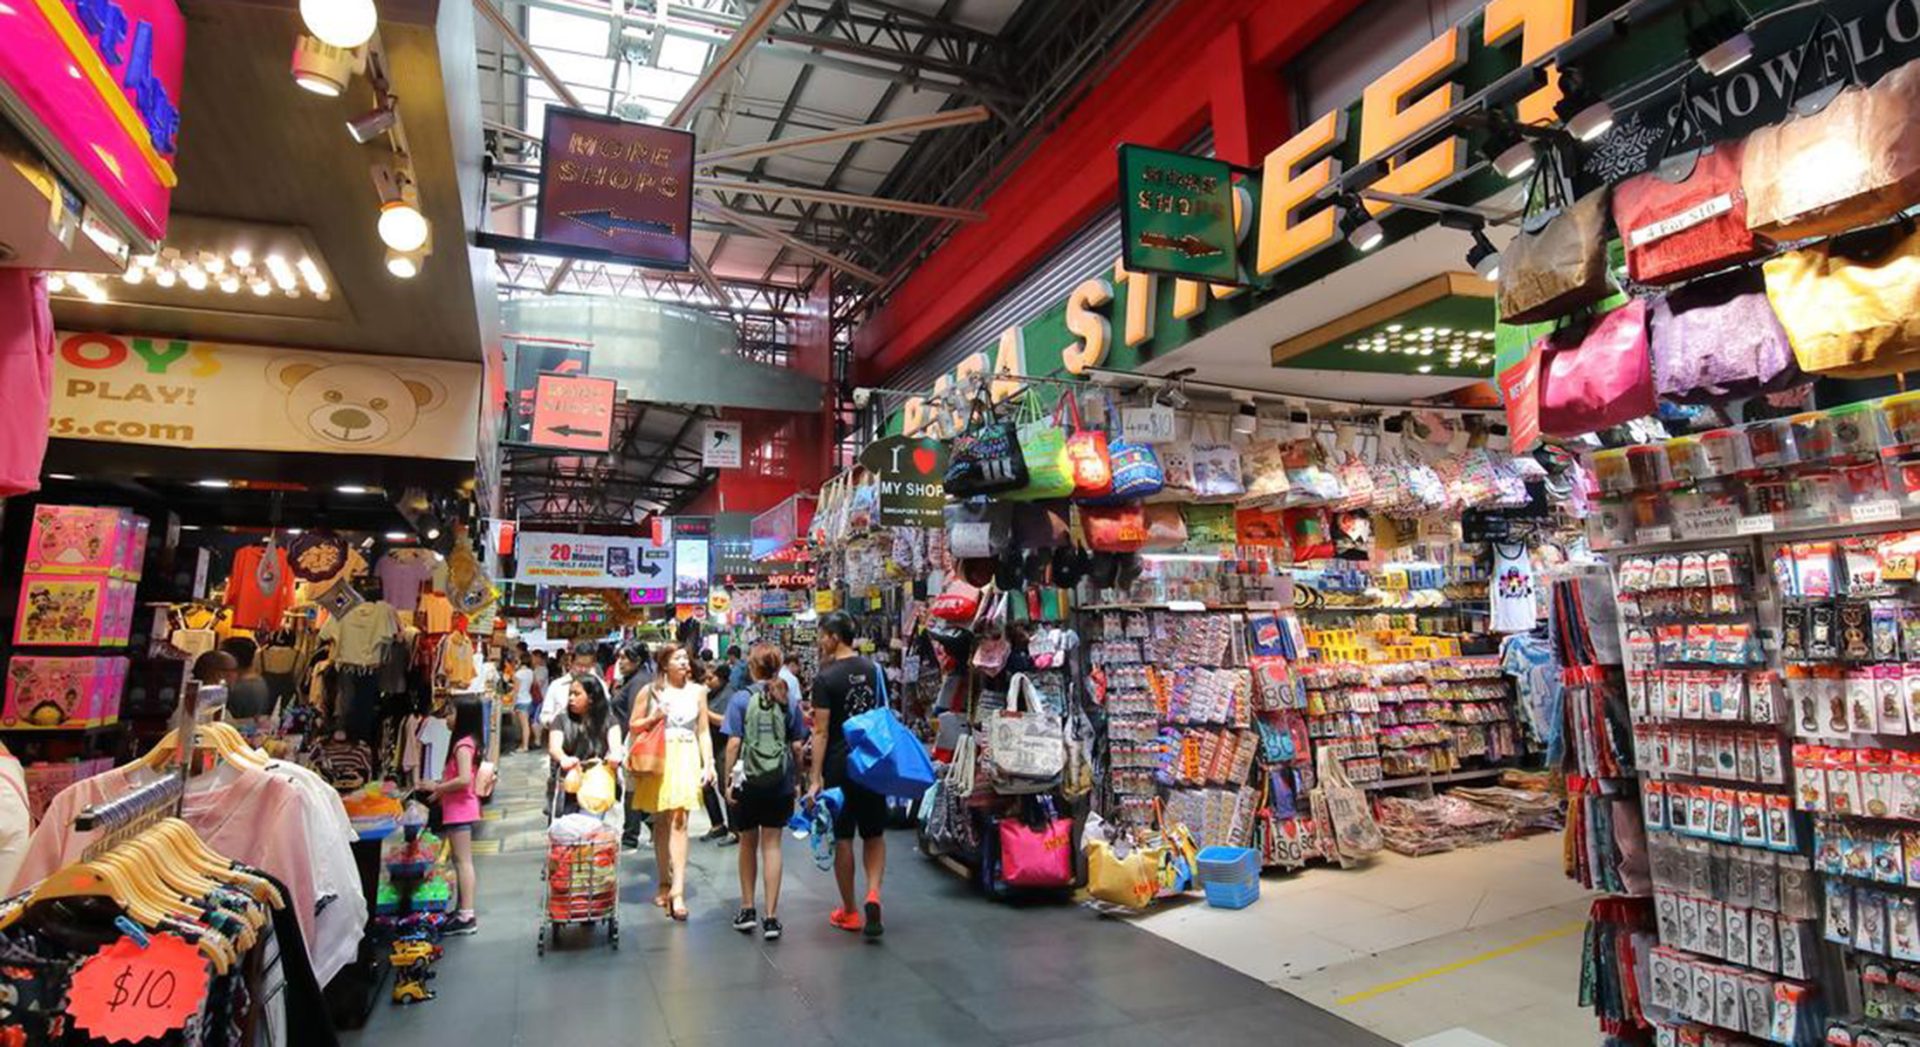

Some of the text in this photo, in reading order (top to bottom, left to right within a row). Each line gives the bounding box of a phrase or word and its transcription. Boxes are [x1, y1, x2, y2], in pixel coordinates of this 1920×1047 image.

[1667, 0, 1920, 148] SNOWFLO
[568, 132, 673, 168] MORE
[558, 160, 679, 199] SHOPS
[1062, 0, 1575, 375] STEET
[66, 379, 197, 405] PLAY!
[890, 444, 906, 474] I
[881, 481, 944, 498] MY SHOP
[550, 543, 571, 561] 20
